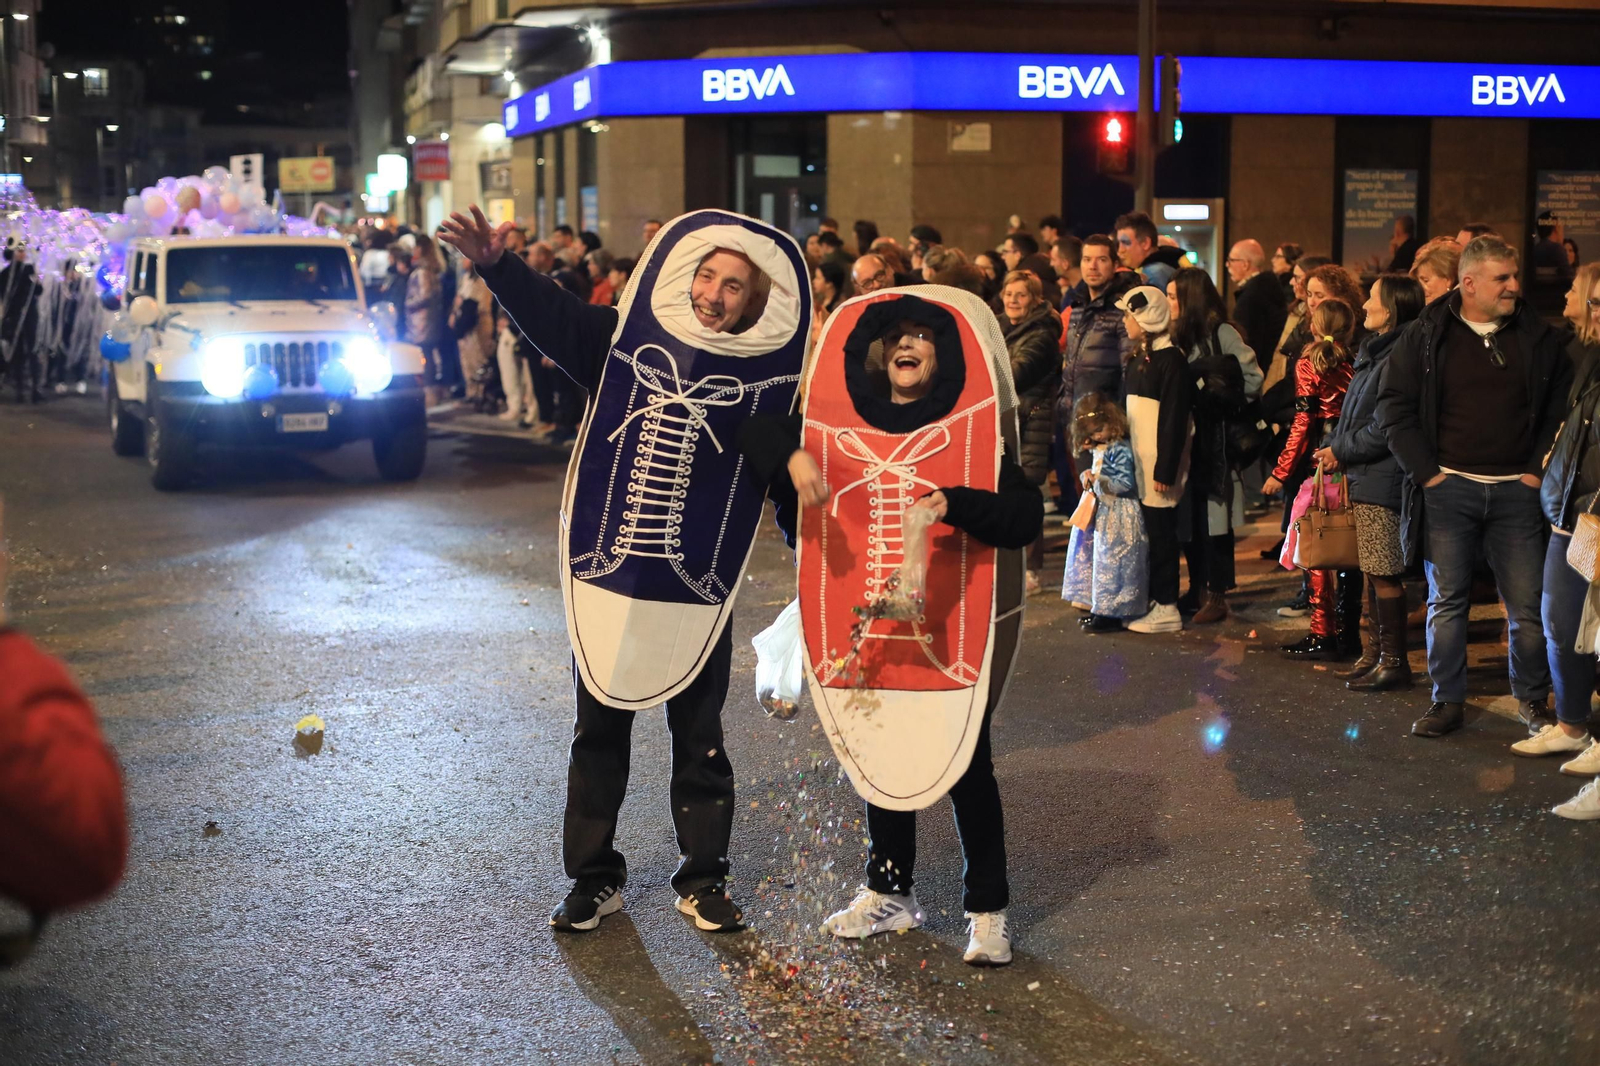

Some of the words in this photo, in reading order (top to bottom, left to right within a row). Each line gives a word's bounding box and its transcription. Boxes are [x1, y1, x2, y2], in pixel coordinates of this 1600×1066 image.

[702, 63, 796, 102] BBVA
[1018, 63, 1125, 99] BBVA
[1471, 73, 1566, 106] BBVA
